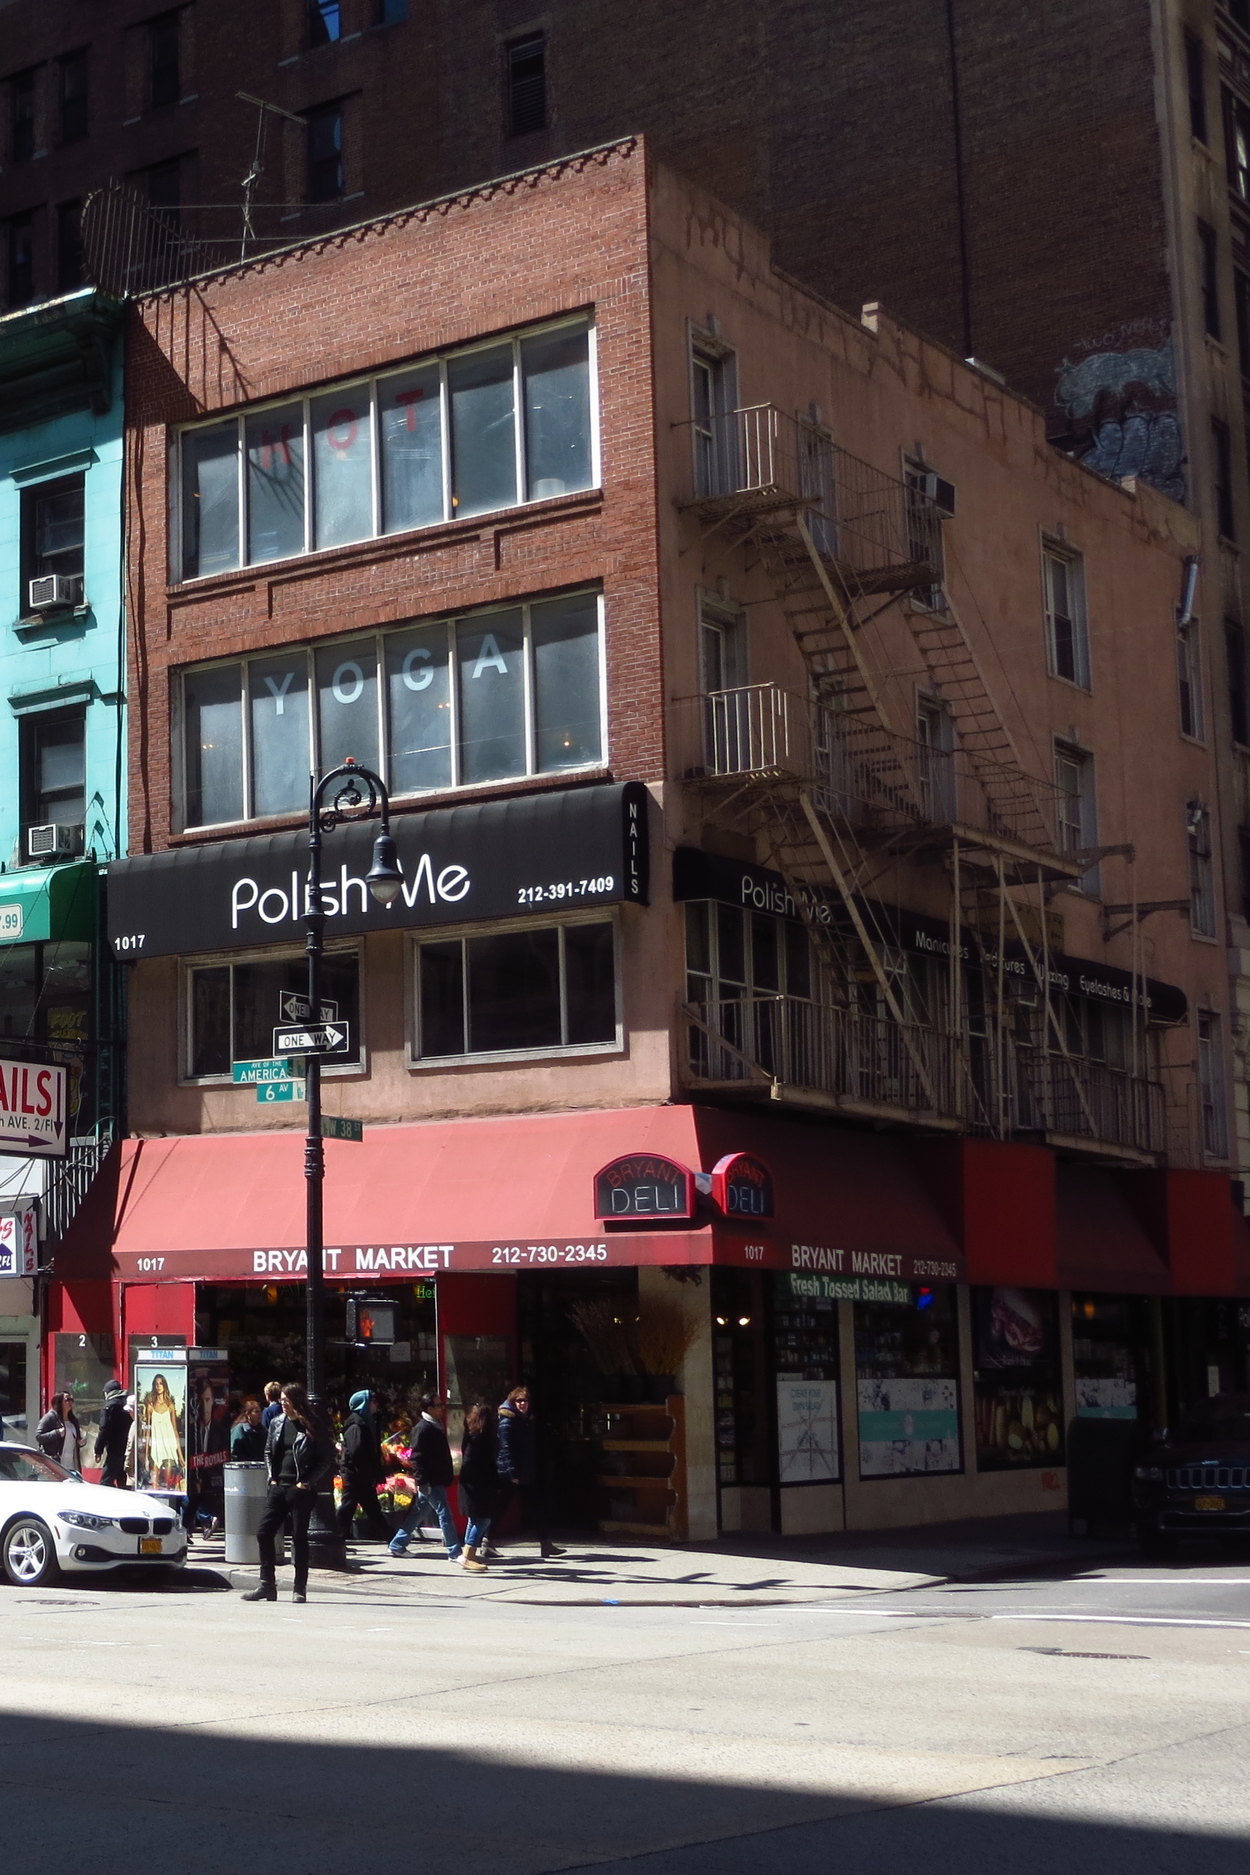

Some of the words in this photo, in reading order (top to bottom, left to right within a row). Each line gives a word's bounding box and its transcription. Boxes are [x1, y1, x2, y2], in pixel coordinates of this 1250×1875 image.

[261, 388, 425, 469] HOT
[263, 633, 508, 716] YOGA
[628, 802, 640, 896] NAILS
[231, 864, 368, 929] Polish
[385, 852, 471, 910] Me
[516, 875, 615, 905] 212-391-7409
[741, 876, 796, 917] Polish
[113, 933, 147, 952] 1017
[289, 1002, 305, 1017] ONE
[283, 1034, 305, 1047] ONE
[313, 1032, 337, 1045] WAY
[239, 1066, 293, 1082] AMERICAS
[265, 1084, 276, 1101] 6
[278, 1083, 289, 1093] AV
[7, 1115, 31, 1130] AVE.
[340, 1121, 352, 1138] 38
[607, 1161, 679, 1189] BRYANT
[610, 1185, 678, 1213] DELI
[727, 1184, 764, 1214] DELI
[23, 1212, 35, 1272] NAILS
[136, 1256, 165, 1272] 1017
[354, 1244, 454, 1270] MARKET
[490, 1243, 608, 1264] 212-730-2345
[744, 1244, 765, 1261] 1017
[791, 1243, 845, 1271] BRYANT
[851, 1250, 903, 1276] MARKET
[912, 1258, 957, 1278] 212-730-2345
[790, 1272, 820, 1296] Fresh
[821, 1275, 860, 1300] Tossed
[862, 1279, 890, 1302] Salad
[892, 1281, 909, 1303] Bar
[78, 1334, 87, 1347] 2
[150, 1336, 159, 1348] 3
[150, 1350, 174, 1360] TITAN
[199, 1350, 218, 1360] TITAN
[192, 1452, 205, 1468] THE
[203, 1450, 228, 1468] ROYALS
